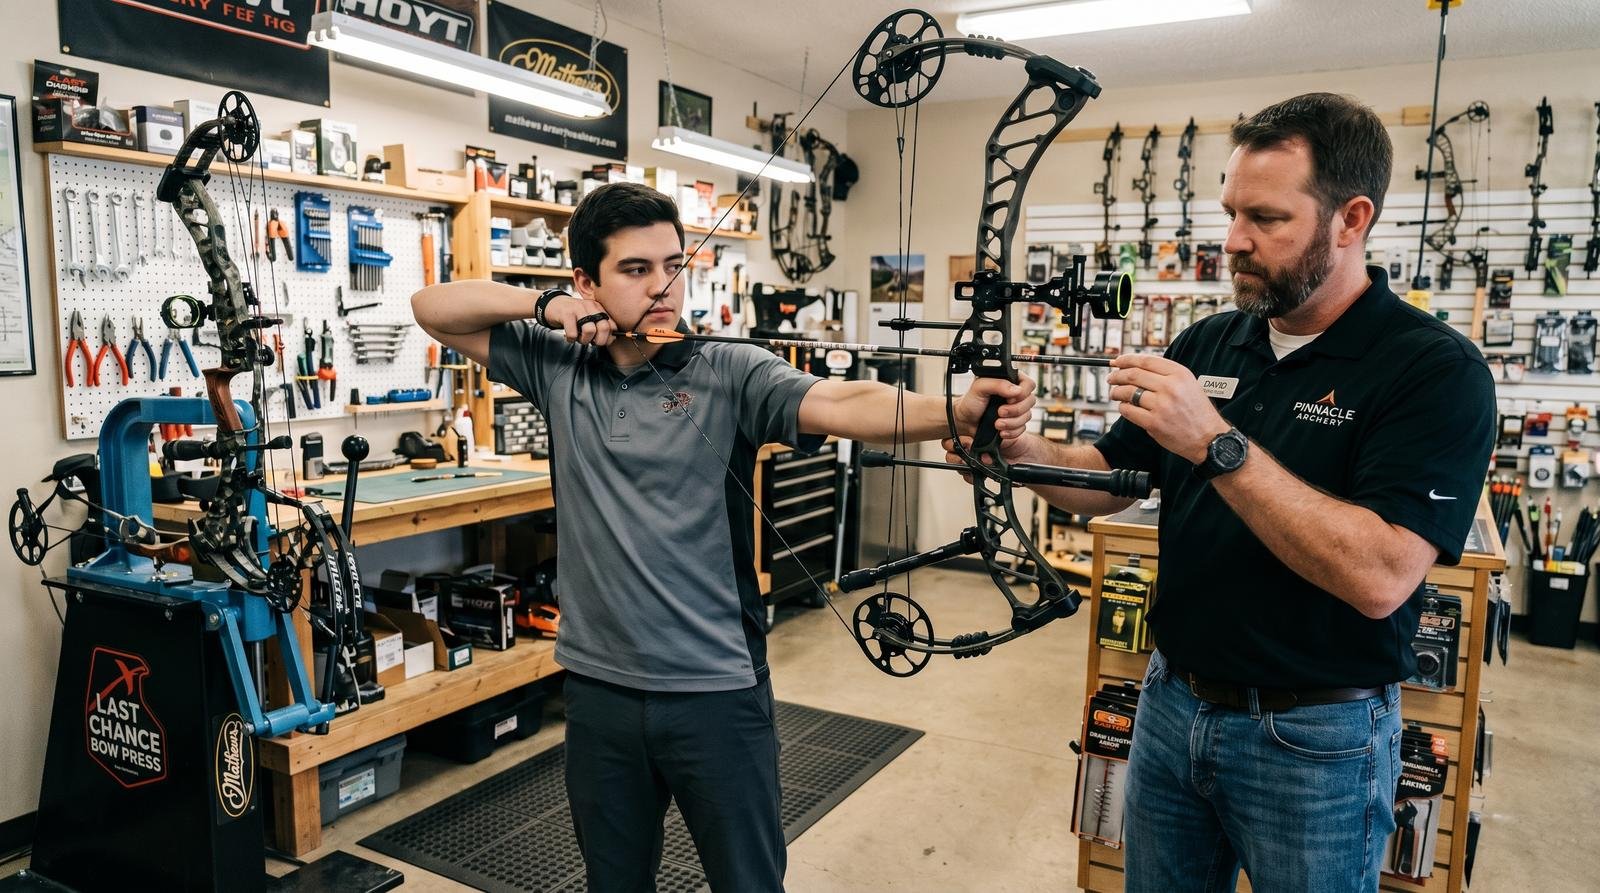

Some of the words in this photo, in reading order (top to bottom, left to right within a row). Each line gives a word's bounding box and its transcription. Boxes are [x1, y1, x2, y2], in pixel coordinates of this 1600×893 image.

[223, 3, 255, 23] FEE
[1203, 380, 1228, 389] DAVID
[1293, 402, 1356, 420] PINNACLE
[1296, 413, 1343, 427] ARCHERY
[96, 692, 140, 723] LAST
[89, 714, 161, 754] CHANCE
[1089, 731, 1107, 740] DRAW
[91, 737, 118, 758] BOW
[121, 746, 161, 772] PRESS
[222, 720, 245, 809] Mathews
